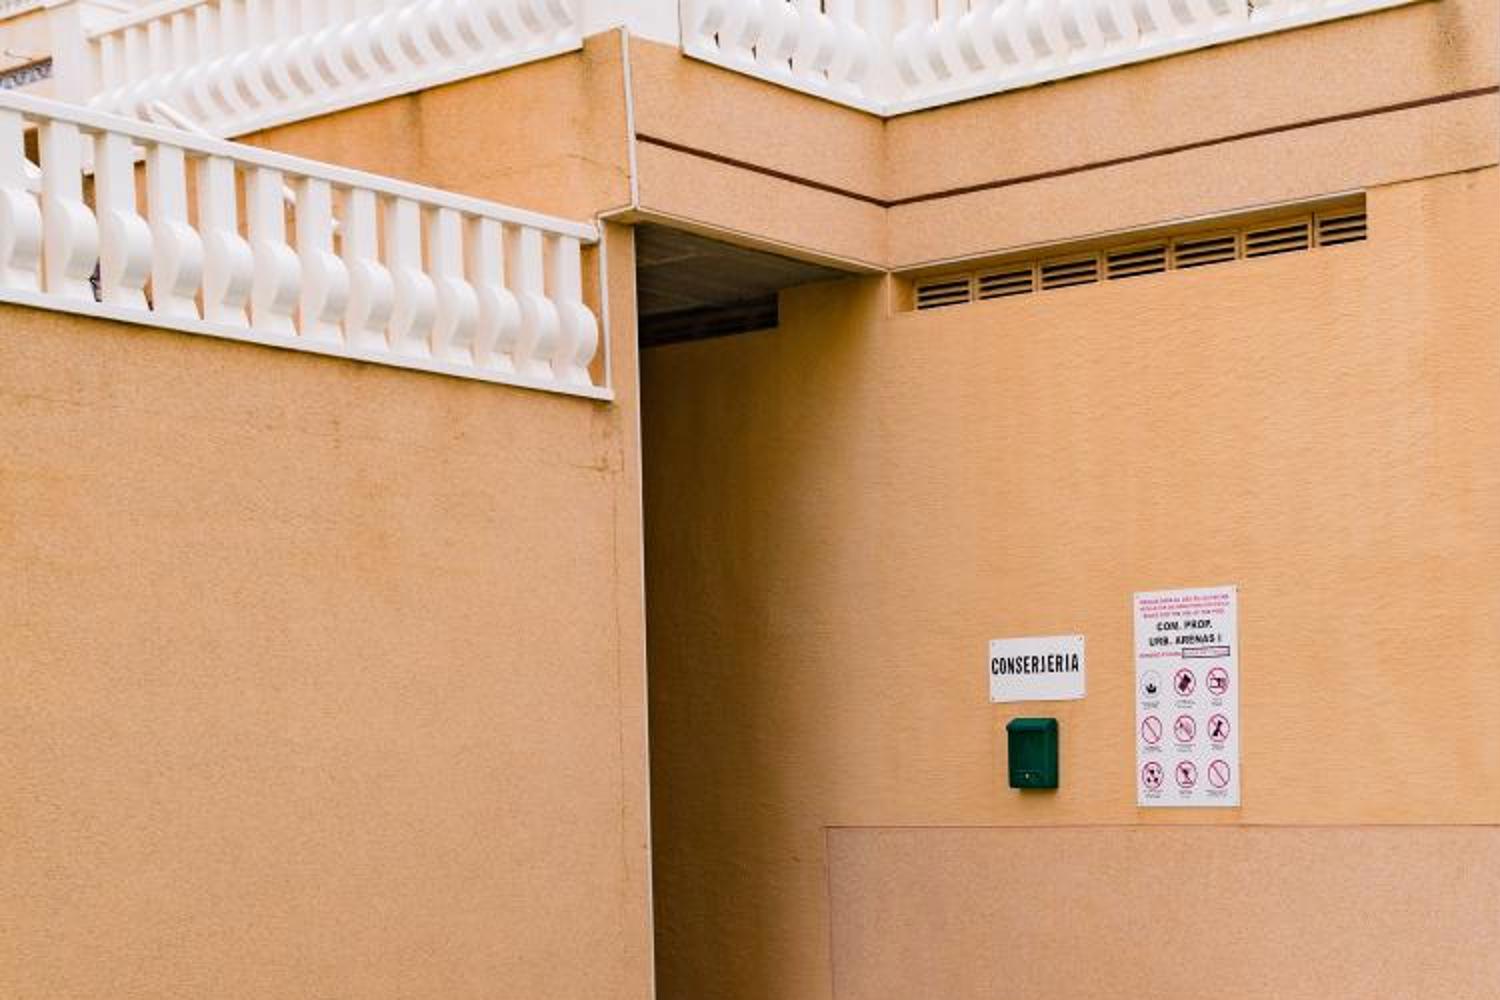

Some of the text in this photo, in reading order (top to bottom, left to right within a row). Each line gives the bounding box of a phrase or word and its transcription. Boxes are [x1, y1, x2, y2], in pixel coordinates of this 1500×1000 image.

[1157, 619, 1213, 631] COM. PROP.
[1149, 636, 1172, 647] URB.
[1175, 634, 1215, 645] ARENAS
[991, 653, 1079, 675] CONSERJERIA
